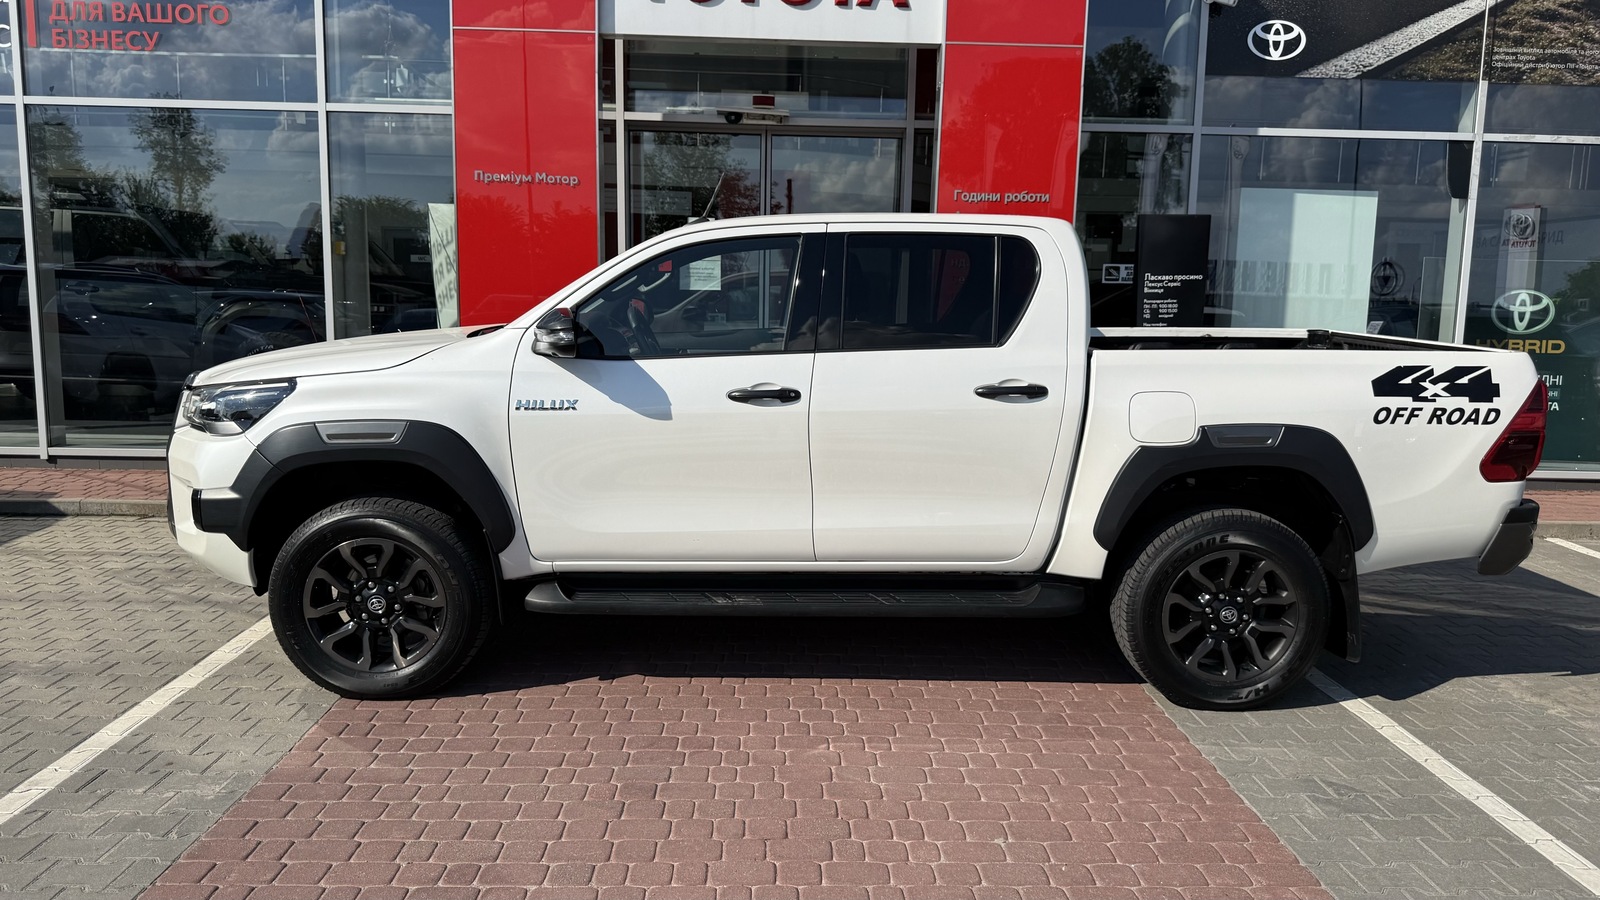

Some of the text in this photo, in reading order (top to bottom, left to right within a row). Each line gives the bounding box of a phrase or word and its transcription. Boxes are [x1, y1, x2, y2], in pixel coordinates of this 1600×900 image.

[49, 0, 230, 25] ДЛЯ ВАШОГО
[51, 28, 160, 51] БІЗНЕСУ
[474, 170, 579, 187] Преміум Мотор
[953, 189, 1051, 205] Години роботи
[1174, 274, 1203, 282] просимо
[1475, 338, 1566, 354] HYBRID
[514, 399, 580, 412] HILUX
[1372, 406, 1502, 426] OFF ROAD
